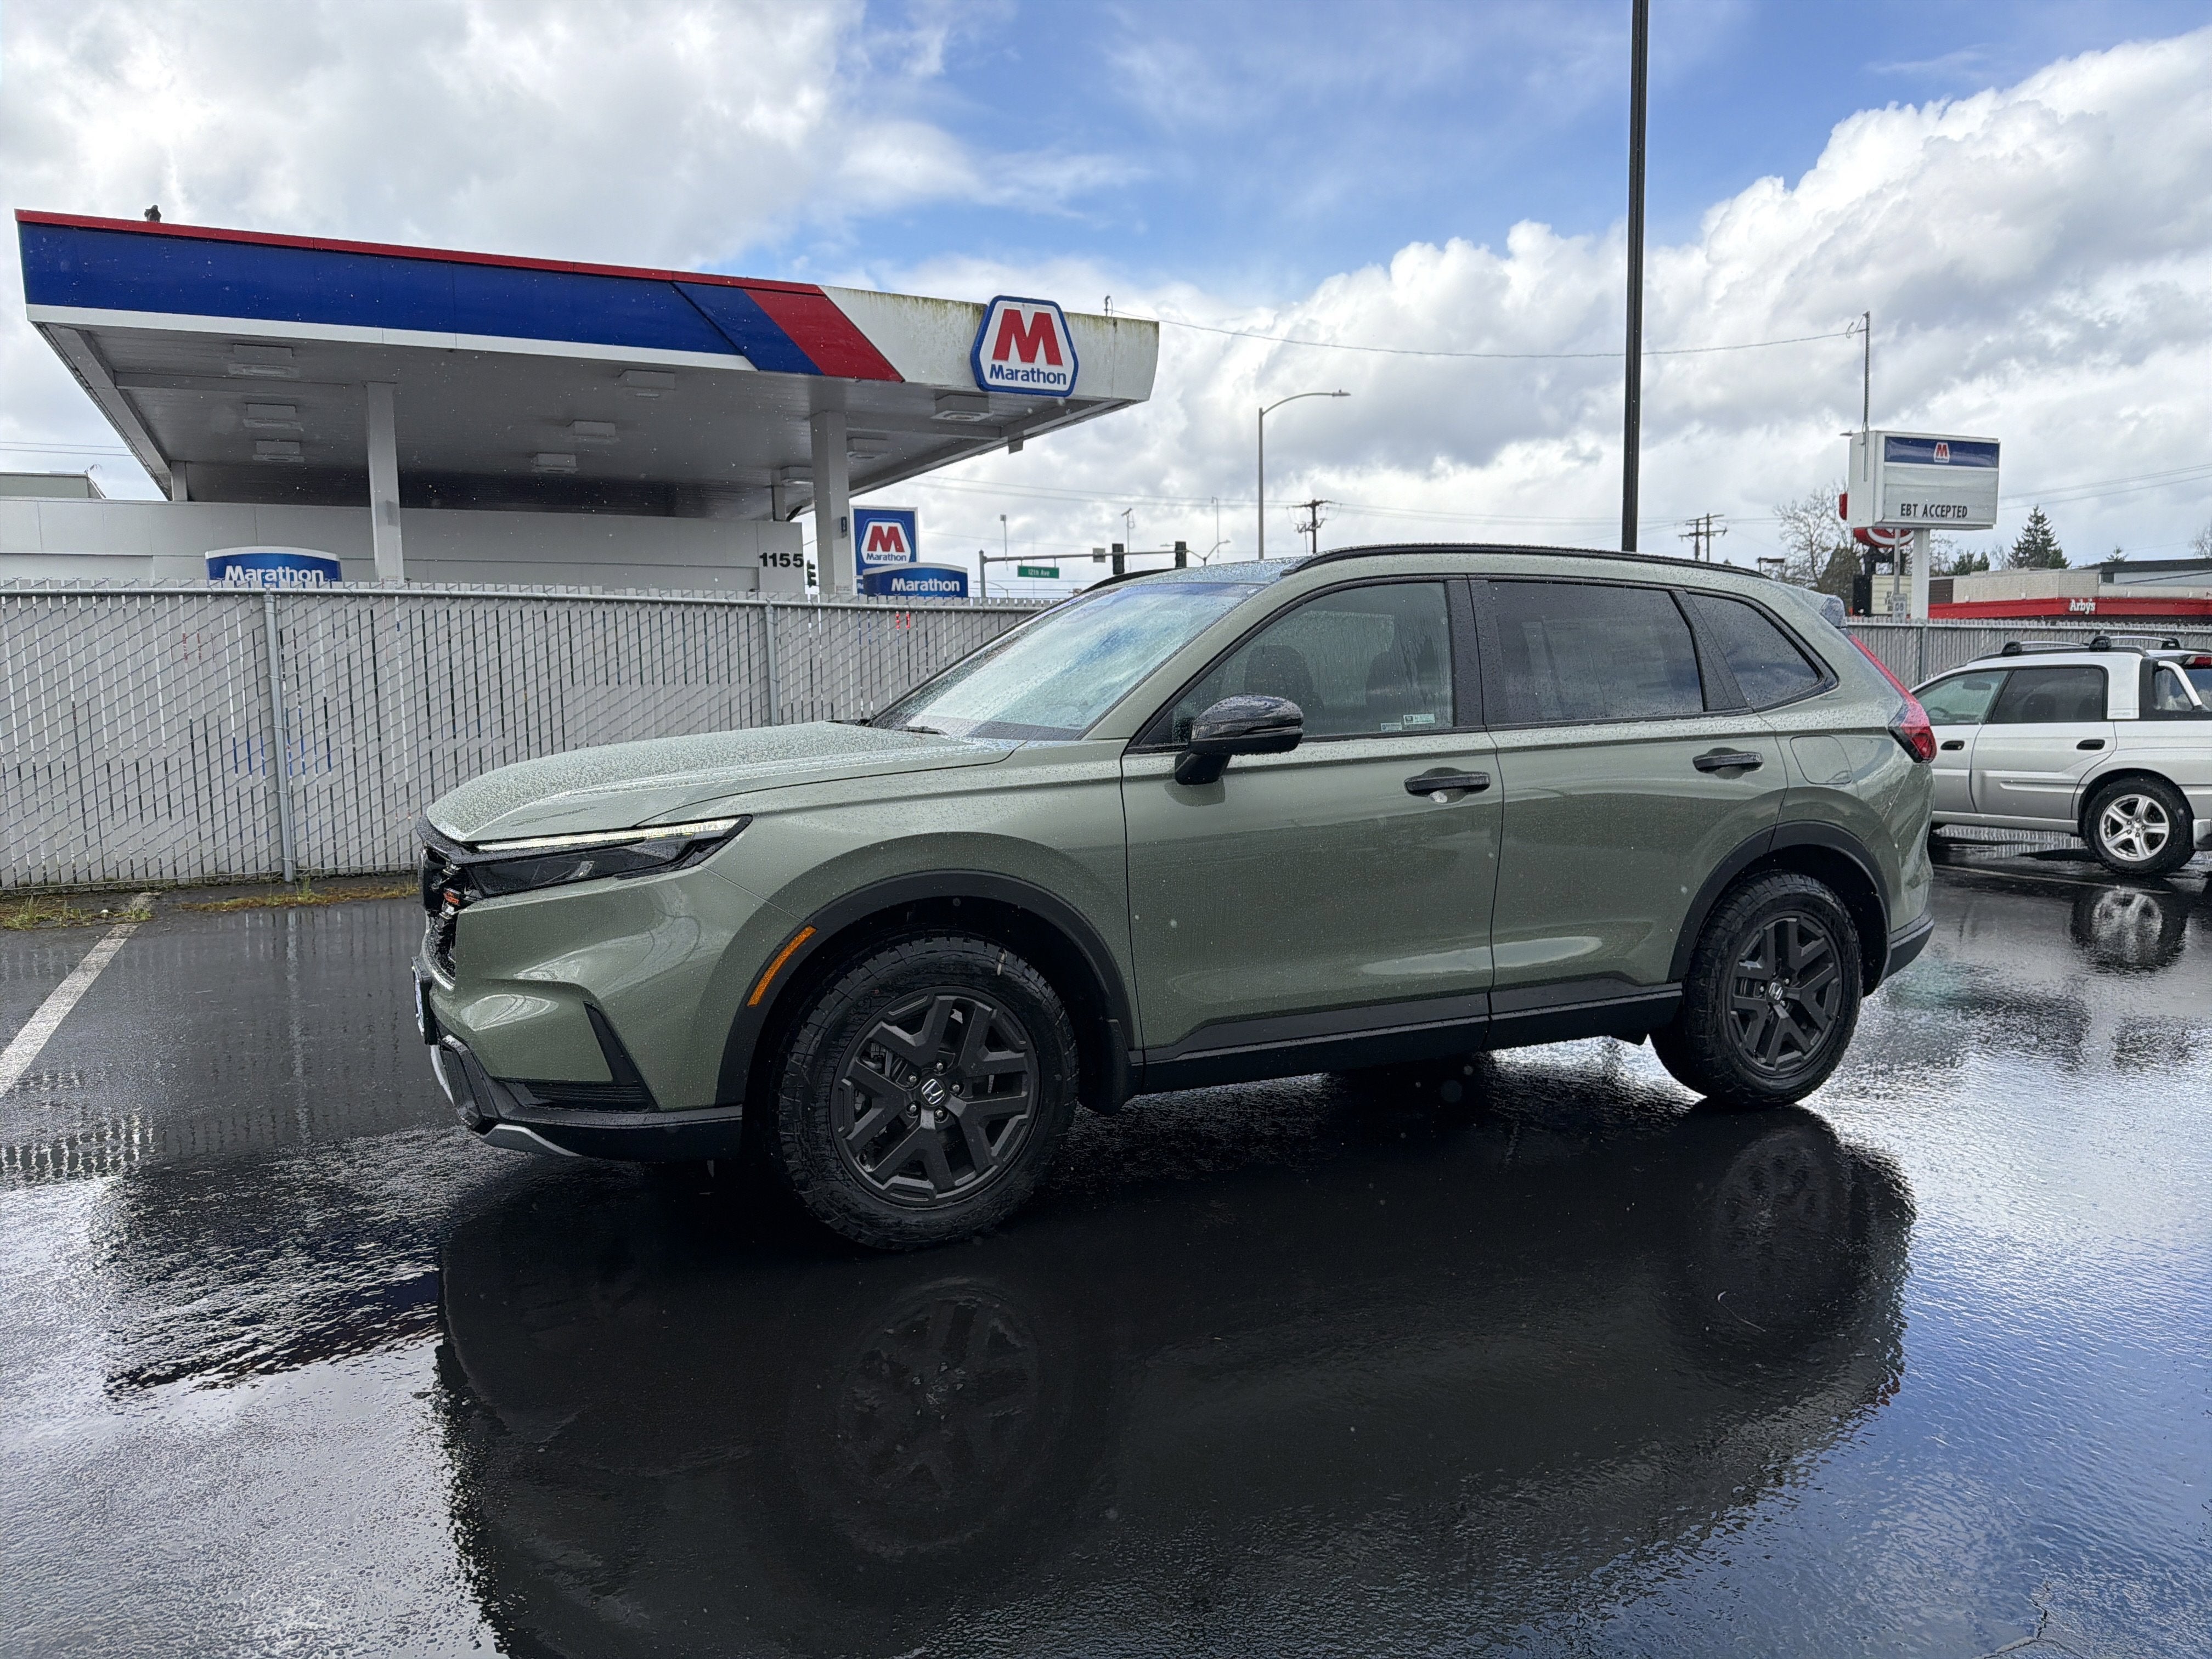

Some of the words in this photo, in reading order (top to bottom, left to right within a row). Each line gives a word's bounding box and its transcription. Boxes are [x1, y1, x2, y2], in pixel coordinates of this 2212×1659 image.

[992, 308, 1063, 366] M
[989, 364, 1066, 385] Marathon
[1900, 504, 1918, 517] EBT
[1922, 504, 1967, 518] ACCEPTED
[867, 526, 905, 552] M
[759, 552, 804, 567] 1155
[866, 553, 906, 561] Marathon
[224, 565, 324, 582] Marathon
[891, 578, 960, 591] Marathon
[2069, 598, 2096, 614] Arby's
